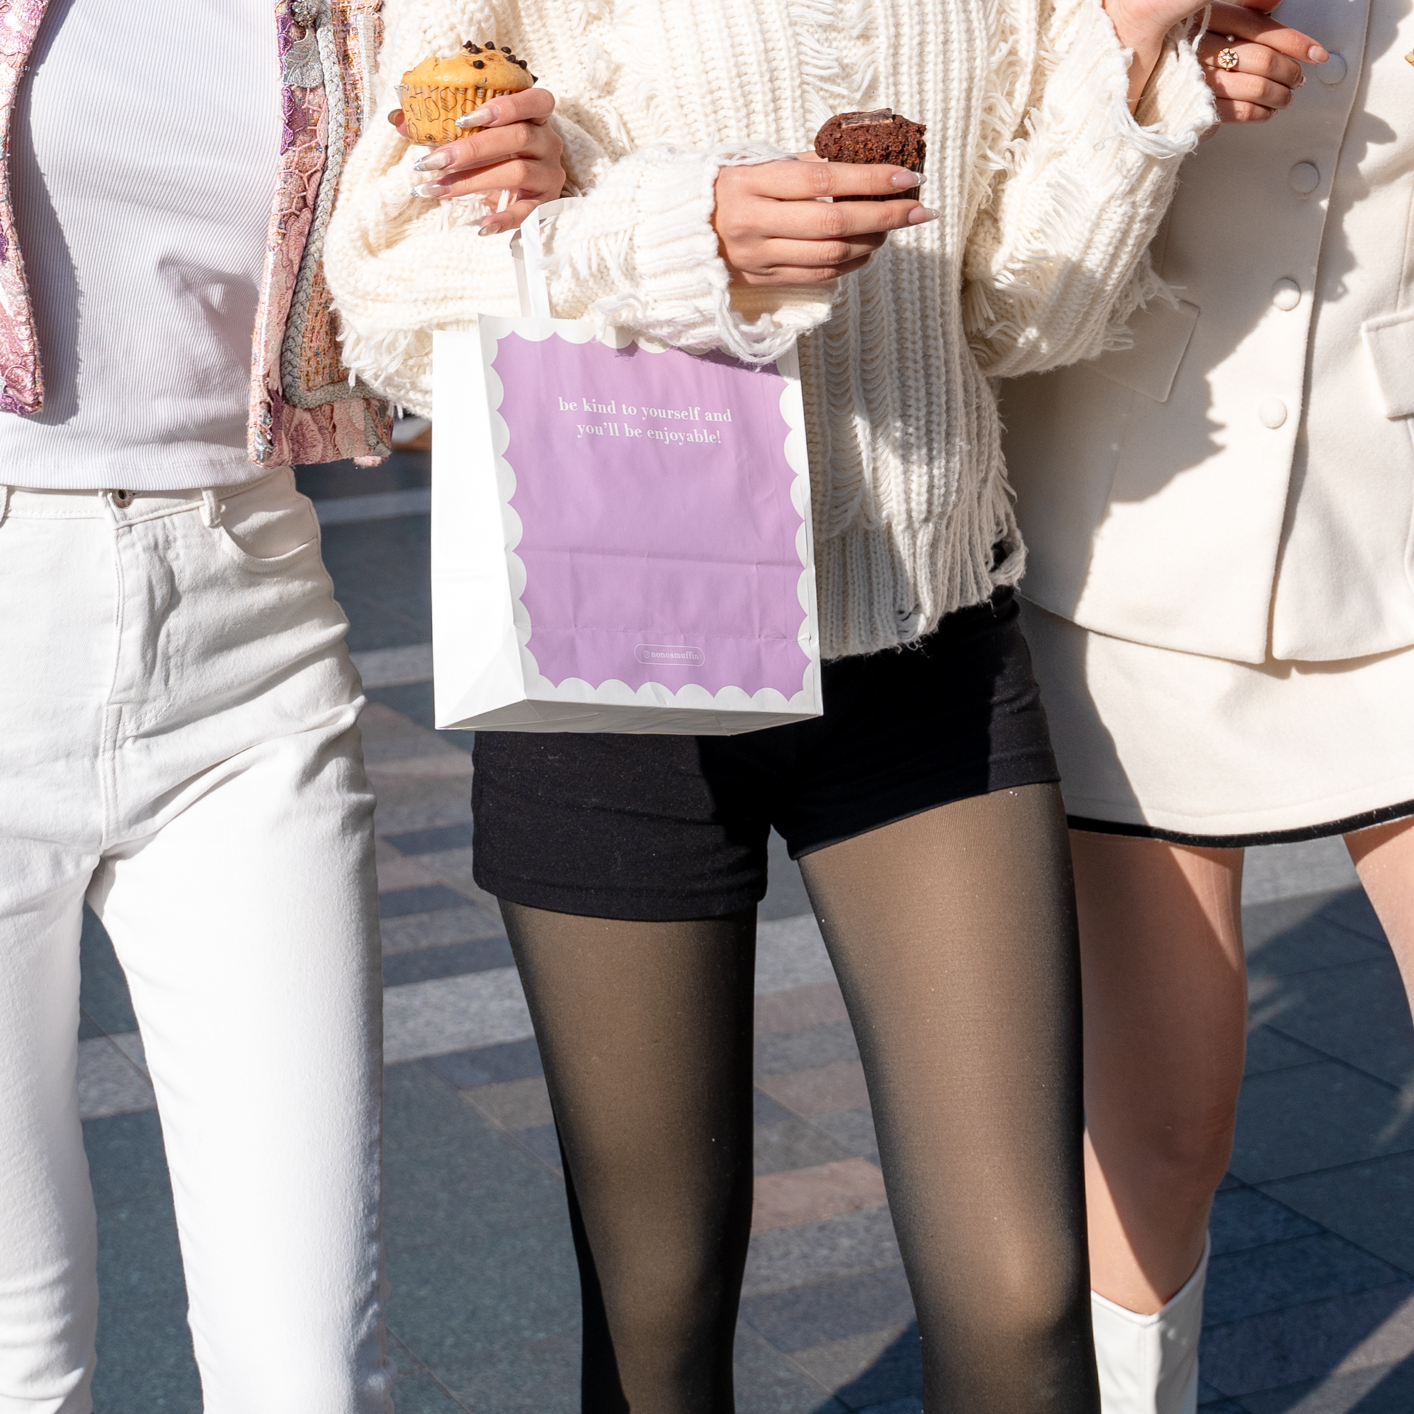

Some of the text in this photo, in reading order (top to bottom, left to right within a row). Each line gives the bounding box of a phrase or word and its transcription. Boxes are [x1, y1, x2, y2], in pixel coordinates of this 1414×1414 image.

[558, 397, 732, 422] be kind to yourself and
[624, 423, 642, 438] be
[647, 427, 721, 445] enjoyable!
